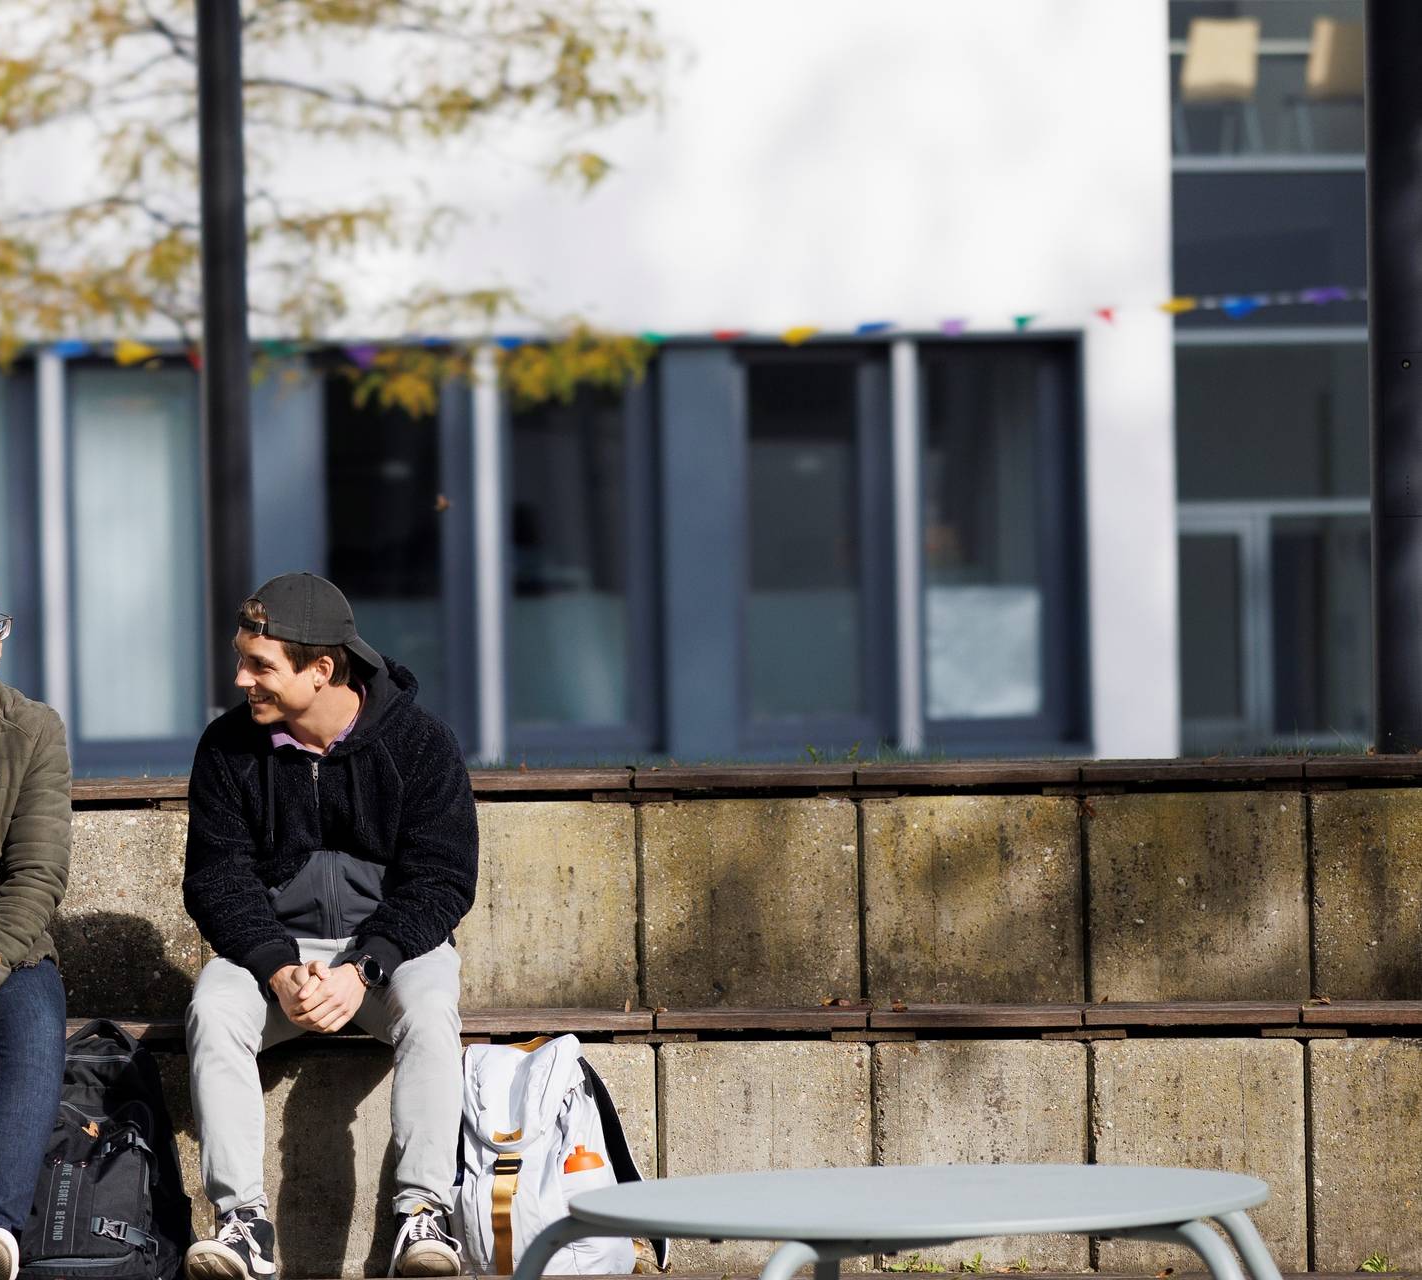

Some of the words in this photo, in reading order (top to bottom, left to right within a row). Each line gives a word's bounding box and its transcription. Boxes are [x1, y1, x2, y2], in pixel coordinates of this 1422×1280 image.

[62, 1163, 73, 1176] ONE
[57, 1180, 70, 1206] DEGREE
[53, 1211, 65, 1240] BEYOND
